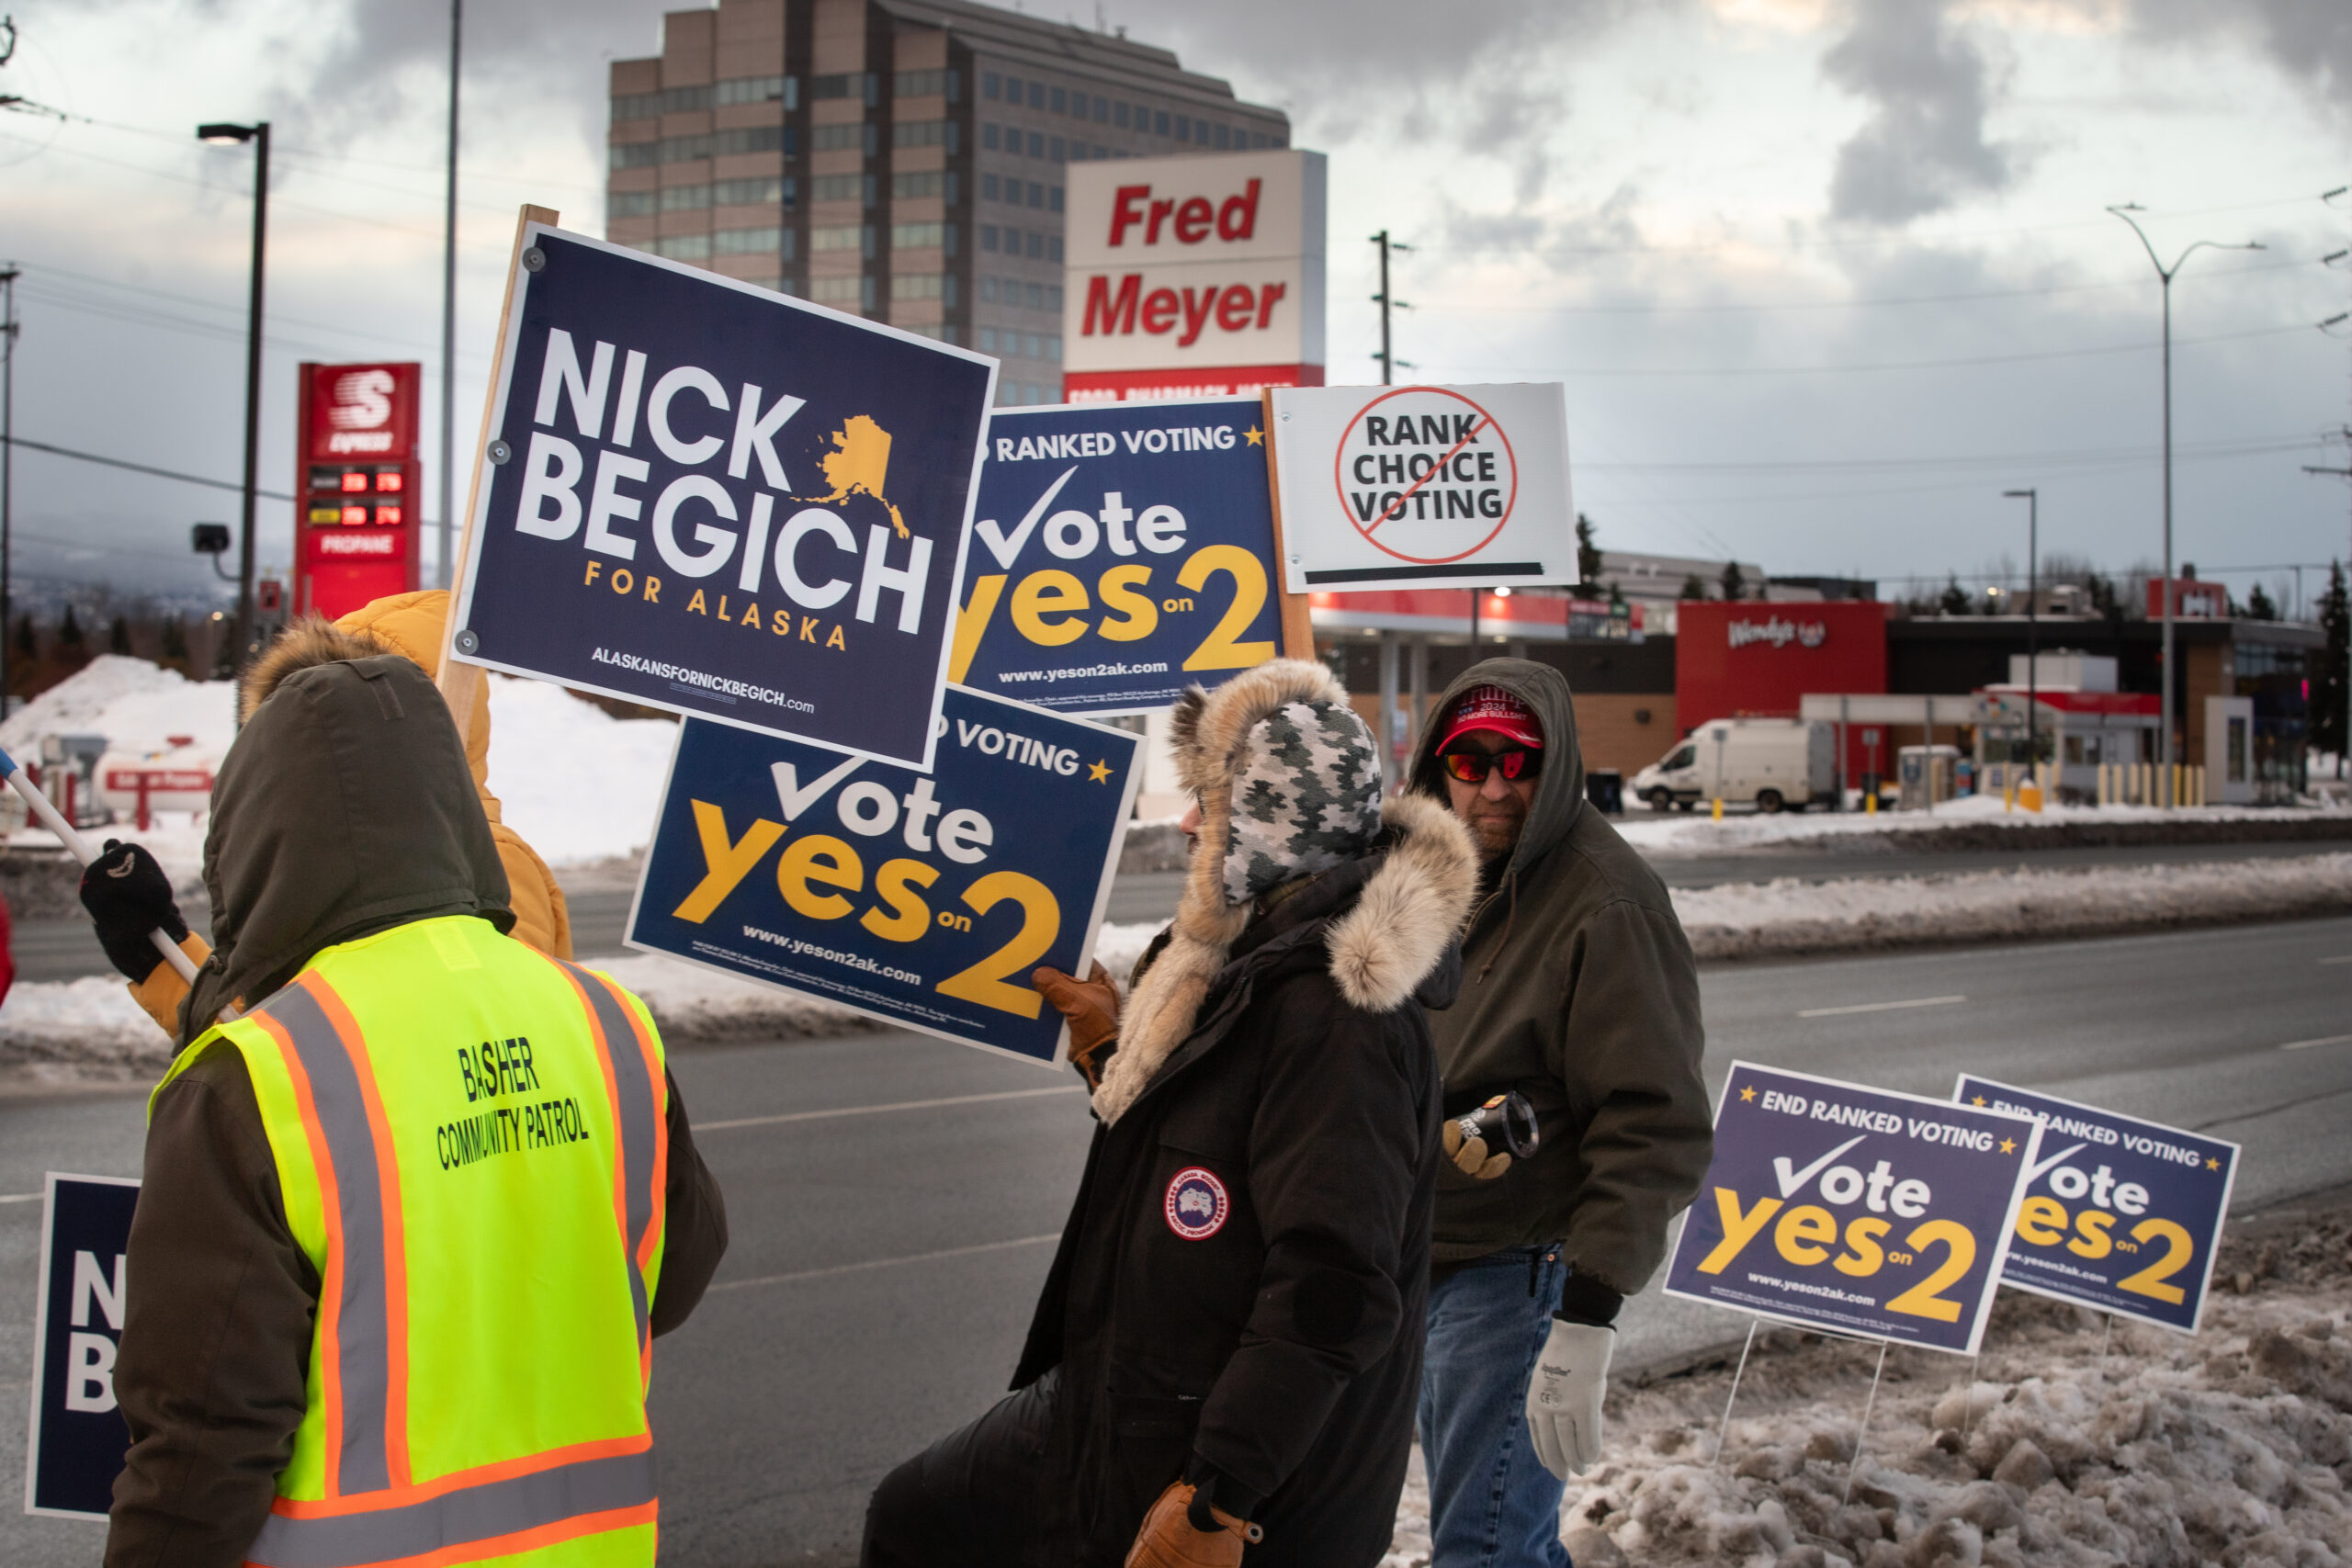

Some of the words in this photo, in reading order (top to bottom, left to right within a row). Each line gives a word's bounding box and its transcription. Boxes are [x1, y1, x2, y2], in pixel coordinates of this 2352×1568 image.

[1108, 177, 1262, 247] Fred
[1081, 273, 1285, 348] Meyer
[534, 327, 808, 492] NICK
[1366, 414, 1479, 446] RANK
[996, 432, 1115, 461] RANKED
[1121, 425, 1236, 454] VOTING
[1353, 451, 1496, 484] CHOICE
[515, 431, 933, 635] BEGICH
[1351, 489, 1503, 522] VOTING
[584, 560, 662, 604] FOR
[686, 589, 846, 651] ALASKA
[1163, 598, 1193, 613] on
[1176, 544, 1276, 671] 2
[592, 647, 815, 714] ALASKANSFORNICKBEGICH.com
[999, 661, 1168, 683] www.yeson2ak.com
[1467, 711, 1488, 720] MORE
[1480, 703, 1506, 712] 2024
[956, 718, 1080, 776] VOTING
[671, 798, 941, 942] yes
[934, 870, 1061, 1021] 2
[937, 910, 972, 933] on
[742, 923, 922, 987] www.yeson2ak.com
[458, 1036, 540, 1102] BASHER
[437, 1107, 520, 1171] COMMUNITY
[525, 1097, 589, 1149] PATROL
[1761, 1090, 1808, 1115] END
[1809, 1101, 1903, 1135] RANKED
[1908, 1119, 1994, 1153] VOTING
[2037, 1111, 2119, 1145] RANKED
[2123, 1133, 2200, 1168] VOTING
[1696, 1186, 1893, 1278] yes
[1888, 1248, 1913, 1267] on
[2016, 1196, 2117, 1259] es
[2116, 1240, 2138, 1255] on
[1747, 1271, 1876, 1306] www.yeson2ak.com
[1884, 1219, 1976, 1324] 2
[2116, 1217, 2194, 1305] 2
